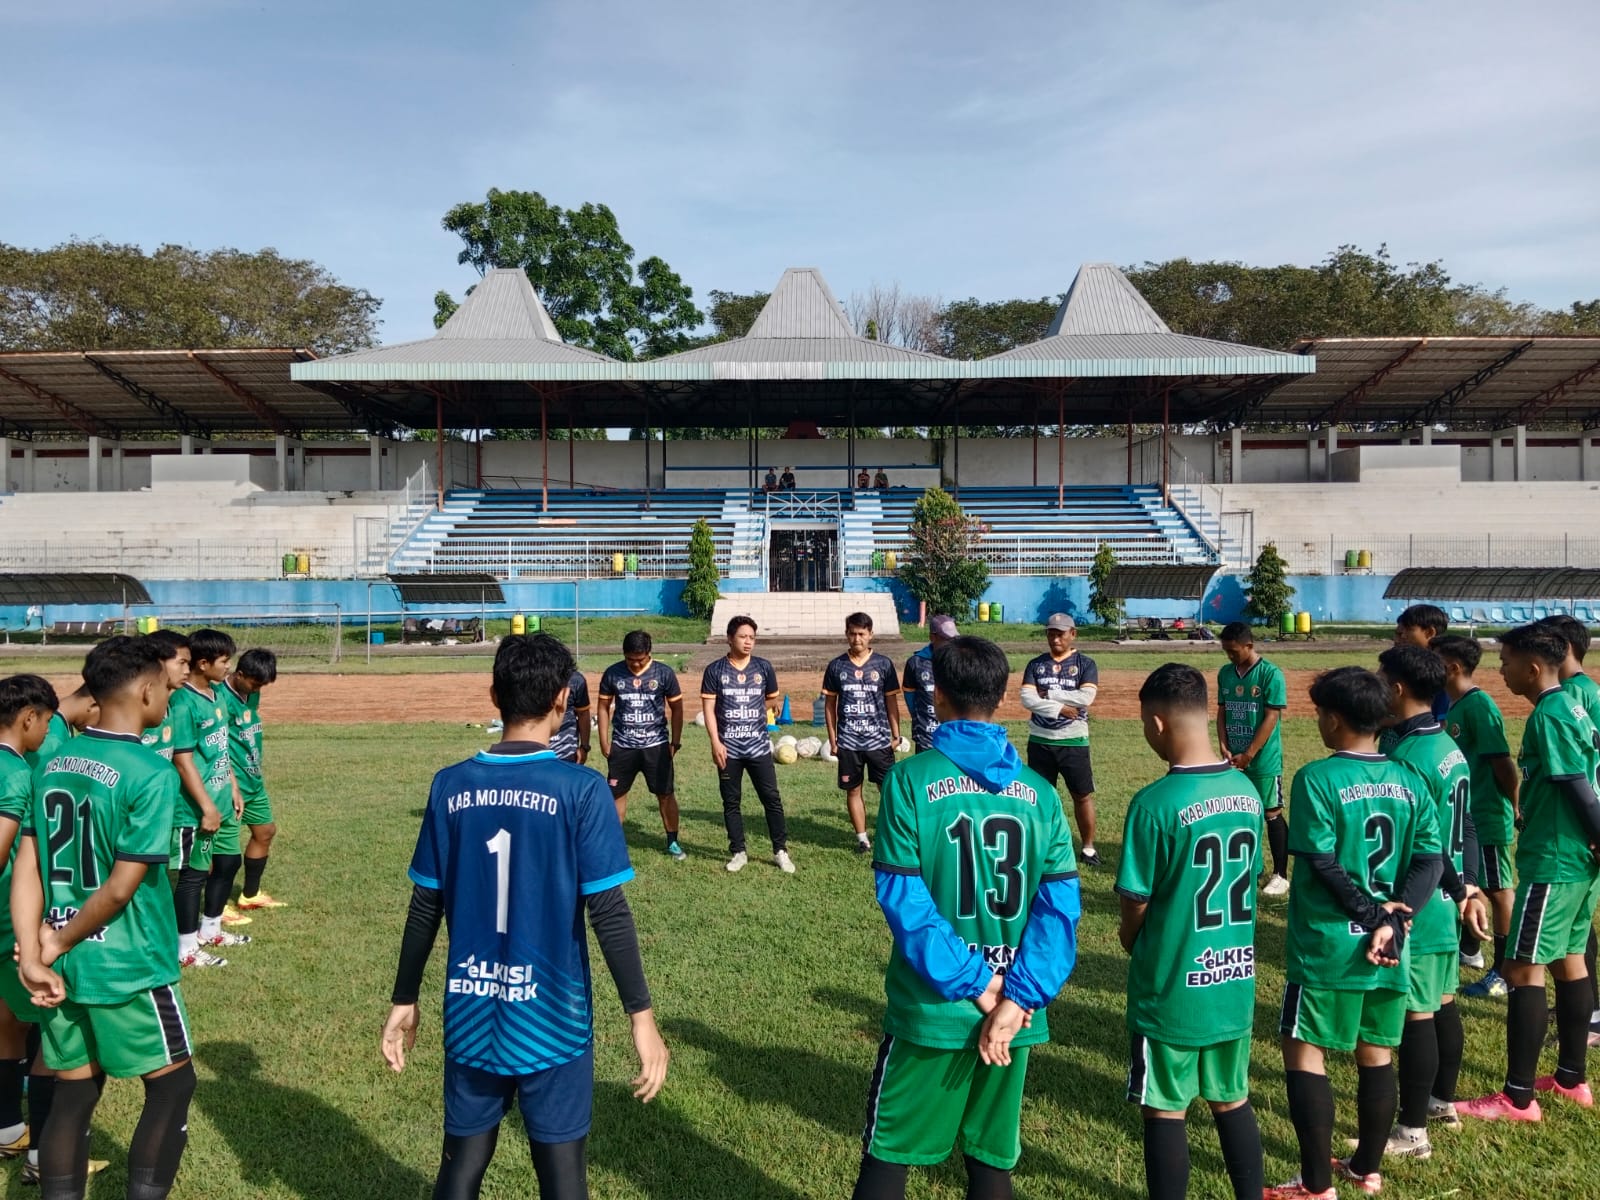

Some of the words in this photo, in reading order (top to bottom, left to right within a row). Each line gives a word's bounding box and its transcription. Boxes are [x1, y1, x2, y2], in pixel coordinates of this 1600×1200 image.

[46, 757, 120, 788] B.MOJOKERTO
[926, 776, 1037, 806] KAB.MOERTO
[43, 788, 101, 890] 21
[946, 812, 1026, 921] 13
[1363, 812, 1396, 897] 2
[485, 828, 512, 934] 1
[1192, 828, 1257, 932] 22
[1186, 963, 1255, 988] EDUPAR
[1202, 946, 1254, 970] eLKIS
[448, 978, 538, 1002] EDUPARK
